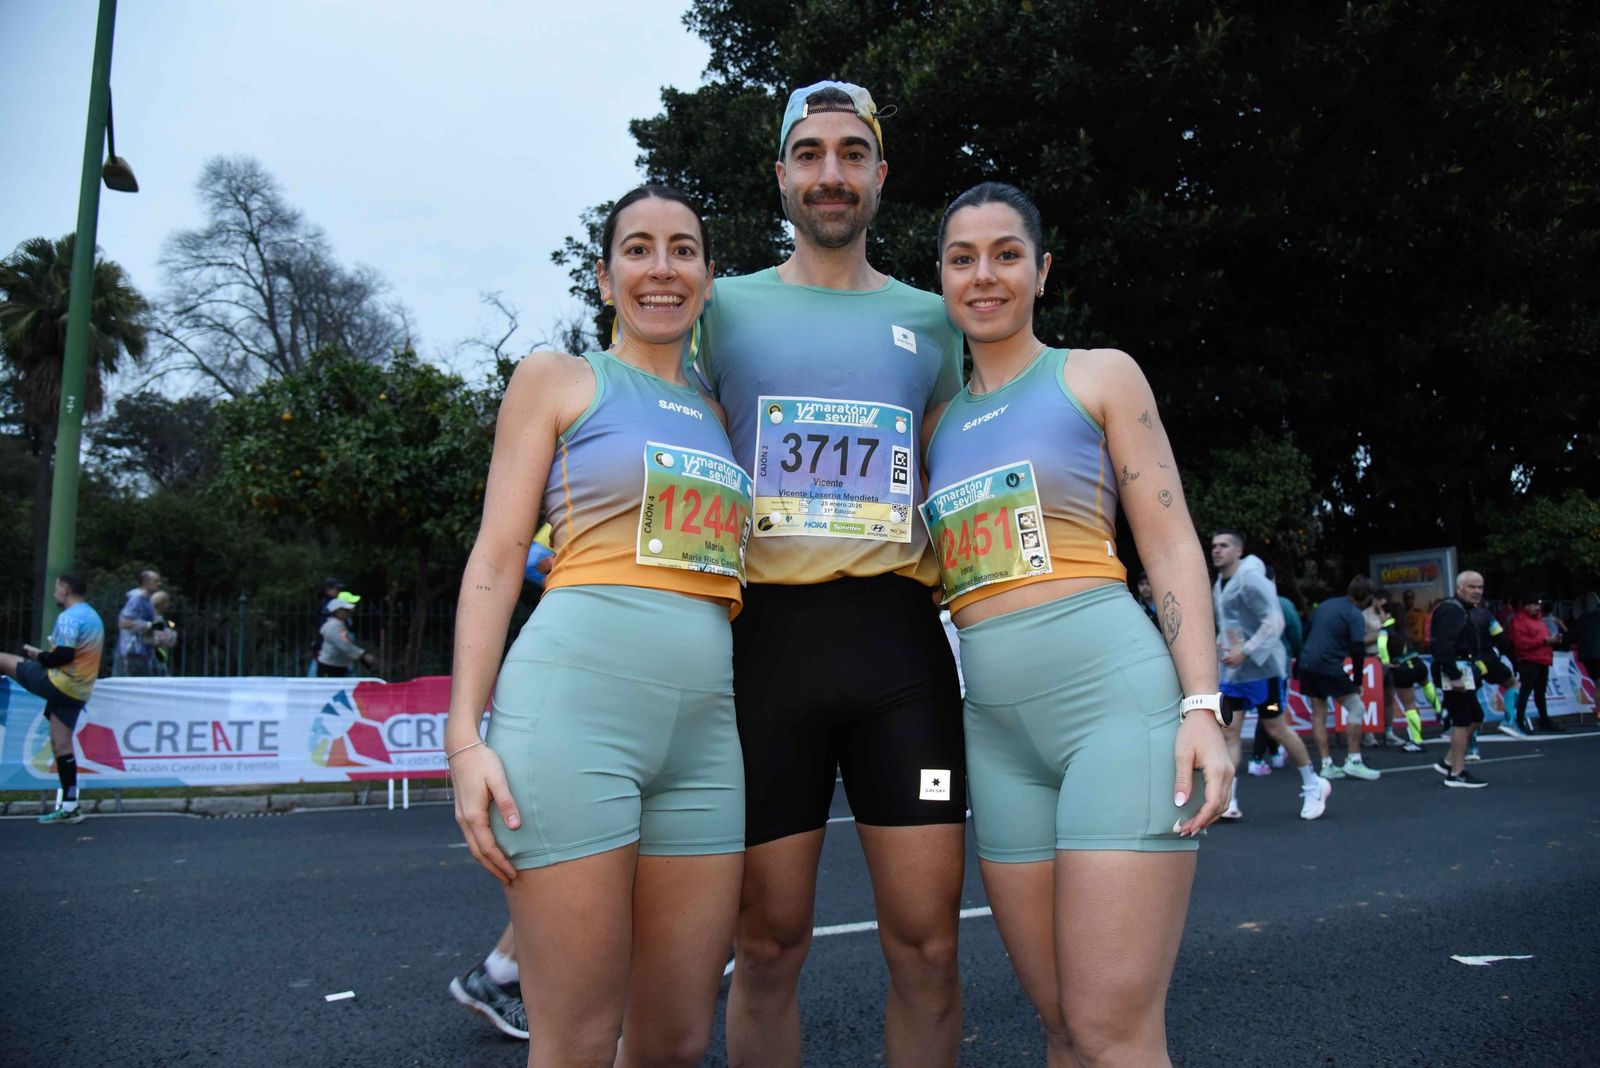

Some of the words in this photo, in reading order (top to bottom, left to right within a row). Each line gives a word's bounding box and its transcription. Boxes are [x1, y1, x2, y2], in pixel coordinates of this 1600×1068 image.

[658, 399, 704, 421] SAYSKY
[812, 402, 868, 416] maratón
[825, 411, 867, 424] sevilla
[962, 404, 1009, 432] SAYSKY
[760, 450, 768, 477] CAJÓN
[781, 432, 880, 477] 3717
[697, 457, 737, 479] maratón
[708, 468, 737, 487] sevilla
[813, 477, 844, 488] Vicente
[939, 480, 983, 504] maratón
[778, 489, 808, 498] Vicente
[809, 490, 841, 499] Laserna
[843, 493, 879, 502] Mendieta
[953, 489, 985, 510] sevilla
[644, 503, 655, 534] CAJÓN
[804, 520, 828, 529] HOKA
[832, 523, 861, 532] Sprinter
[704, 555, 720, 565] Rico
[123, 720, 279, 753] CREATE
[387, 718, 448, 748] CR
[130, 762, 169, 773] Acción
[171, 762, 216, 773] Creativa
[219, 761, 235, 772] de
[237, 761, 279, 772] Eventos
[396, 756, 431, 766] Acción
